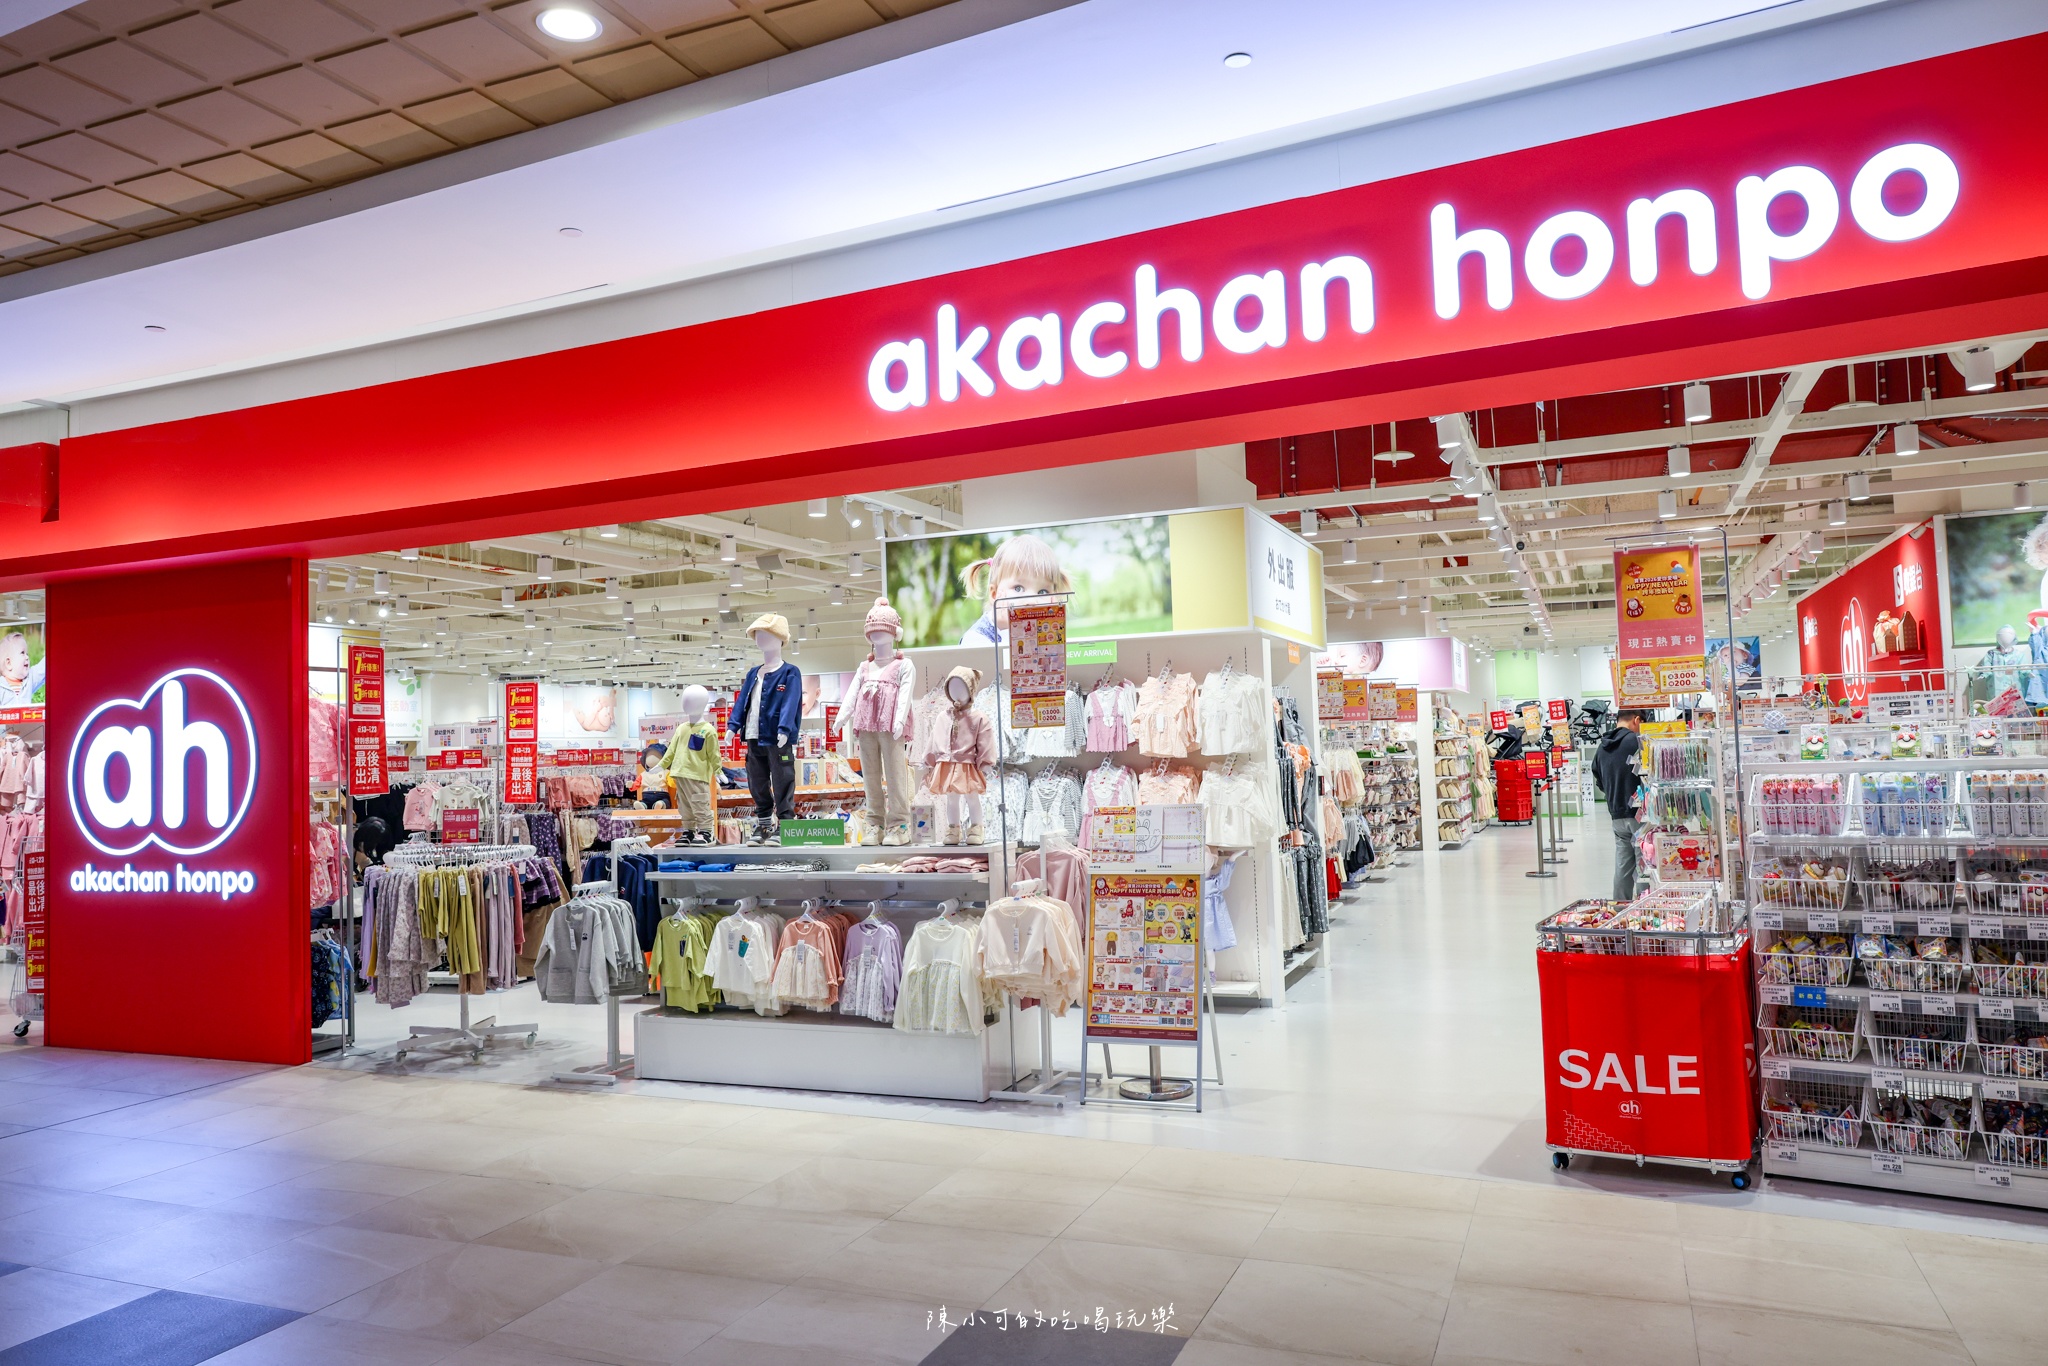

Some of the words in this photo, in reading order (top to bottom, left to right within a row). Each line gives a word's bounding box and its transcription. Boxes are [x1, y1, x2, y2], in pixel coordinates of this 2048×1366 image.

[868, 256, 1374, 411] akachan
[1430, 143, 1959, 319] honpo
[1267, 547, 1294, 590] 外出服
[1670, 579, 1688, 587] YEAR
[1628, 634, 1696, 649] 現正熱賣中
[1843, 603, 1865, 686] ah
[1083, 649, 1113, 657] ARRIVAL
[84, 679, 229, 829] ah
[355, 750, 380, 767] 最後
[356, 767, 380, 784] 出清
[511, 768, 532, 781] 最後
[511, 782, 532, 795] 出清
[784, 828, 805, 837] NEW
[806, 828, 840, 837] ARRIVAL
[28, 880, 45, 896] 最後
[70, 863, 169, 893] akachan
[176, 863, 254, 901] honpo
[1558, 1048, 1700, 1095] SALE
[1620, 1100, 1639, 1115] ah
